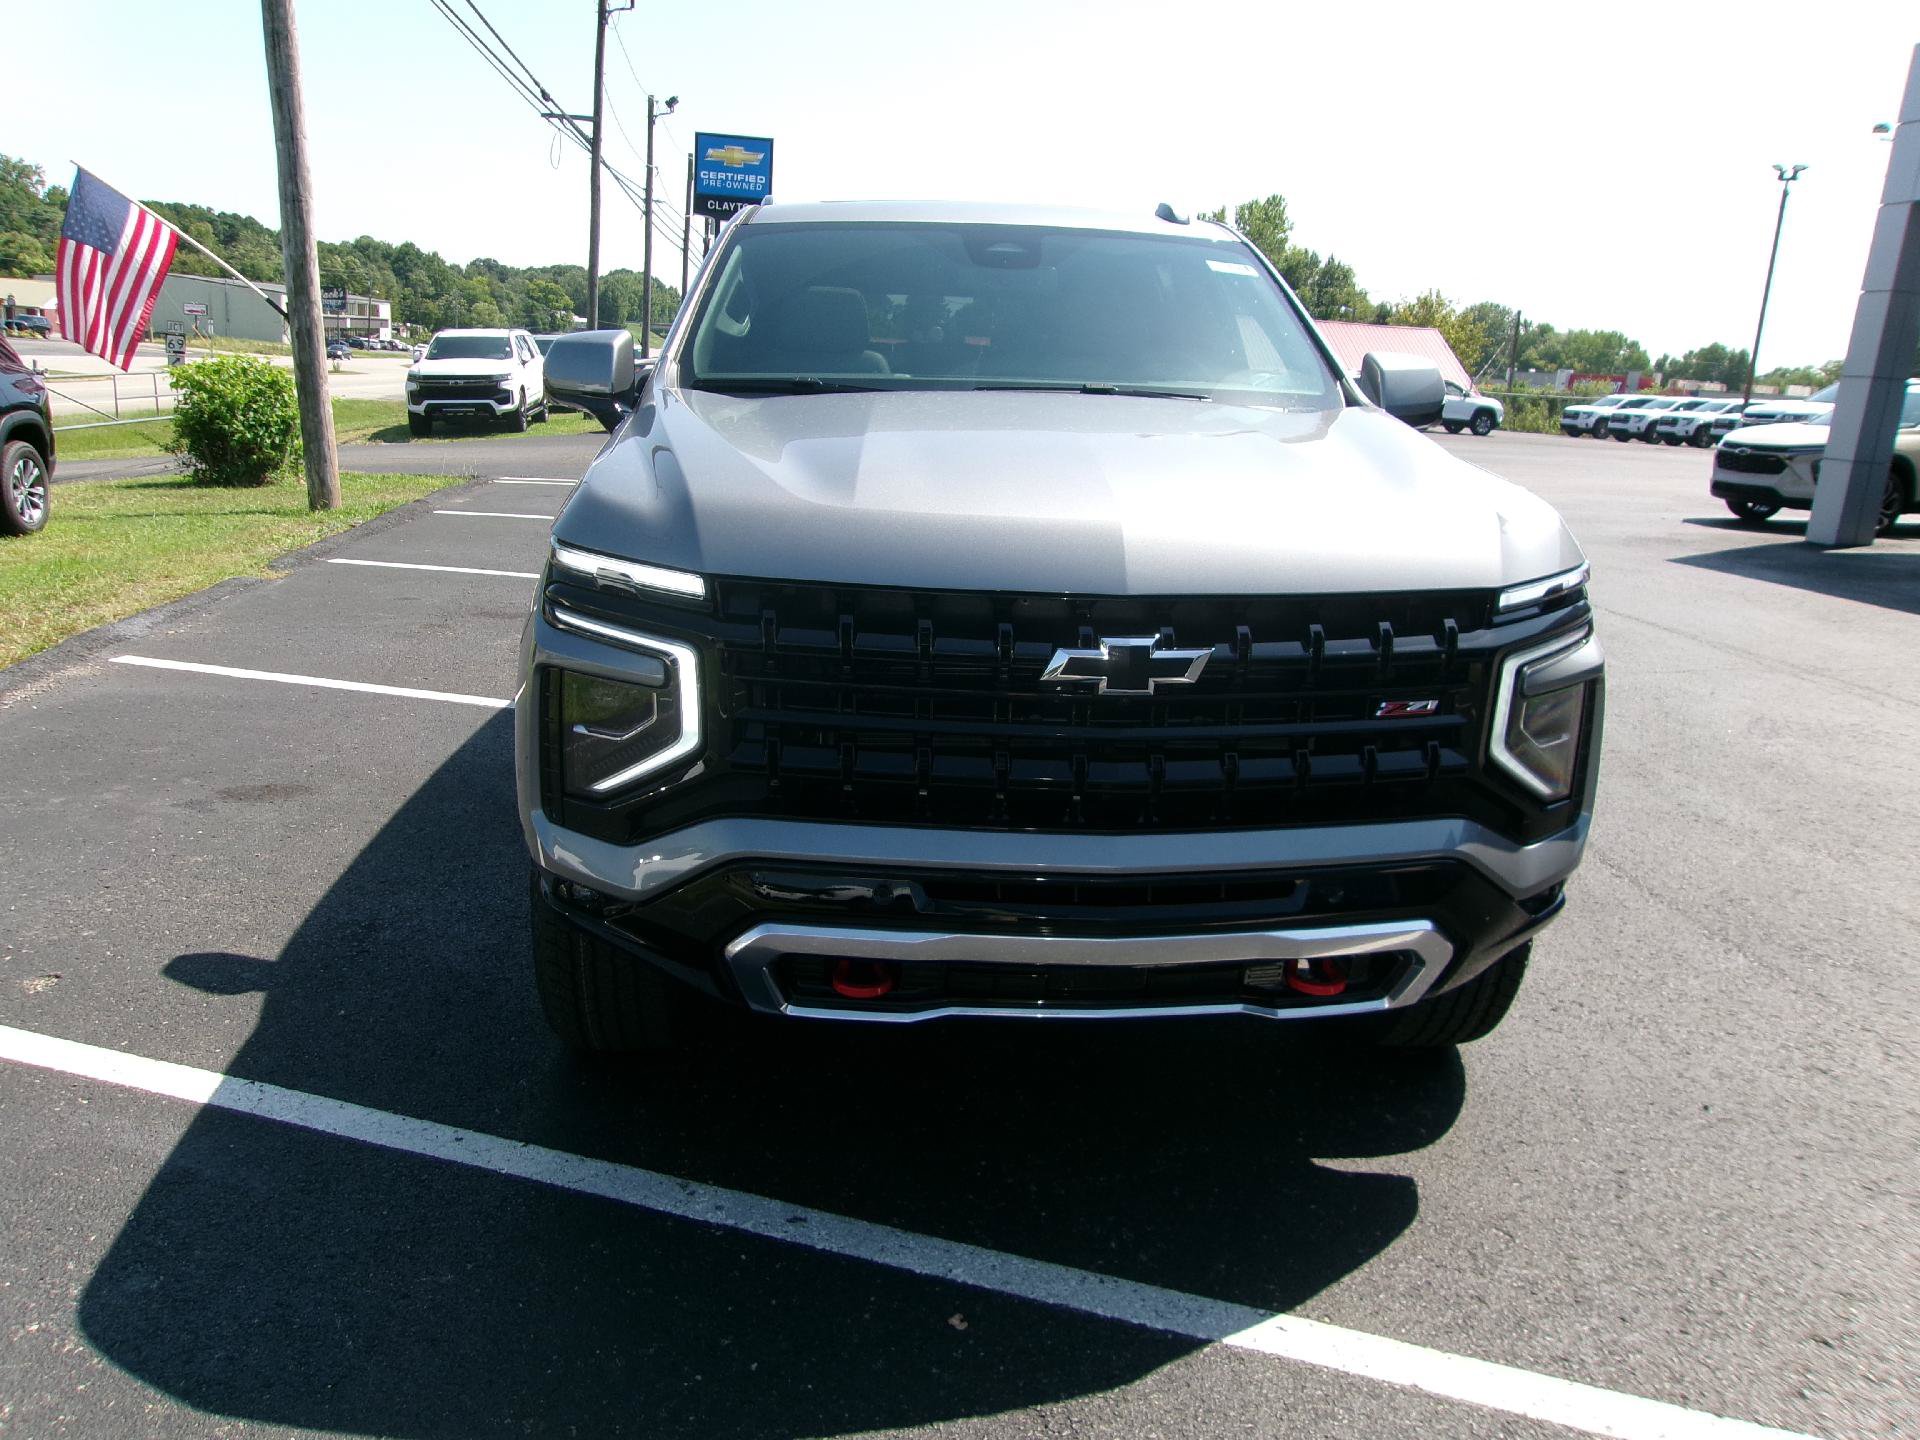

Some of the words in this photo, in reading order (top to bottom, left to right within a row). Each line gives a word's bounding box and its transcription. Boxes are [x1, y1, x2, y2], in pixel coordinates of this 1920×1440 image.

[700, 170, 766, 184] CERTIFIED
[703, 179, 763, 191] PRE-OWNED
[167, 338, 185, 350] 69
